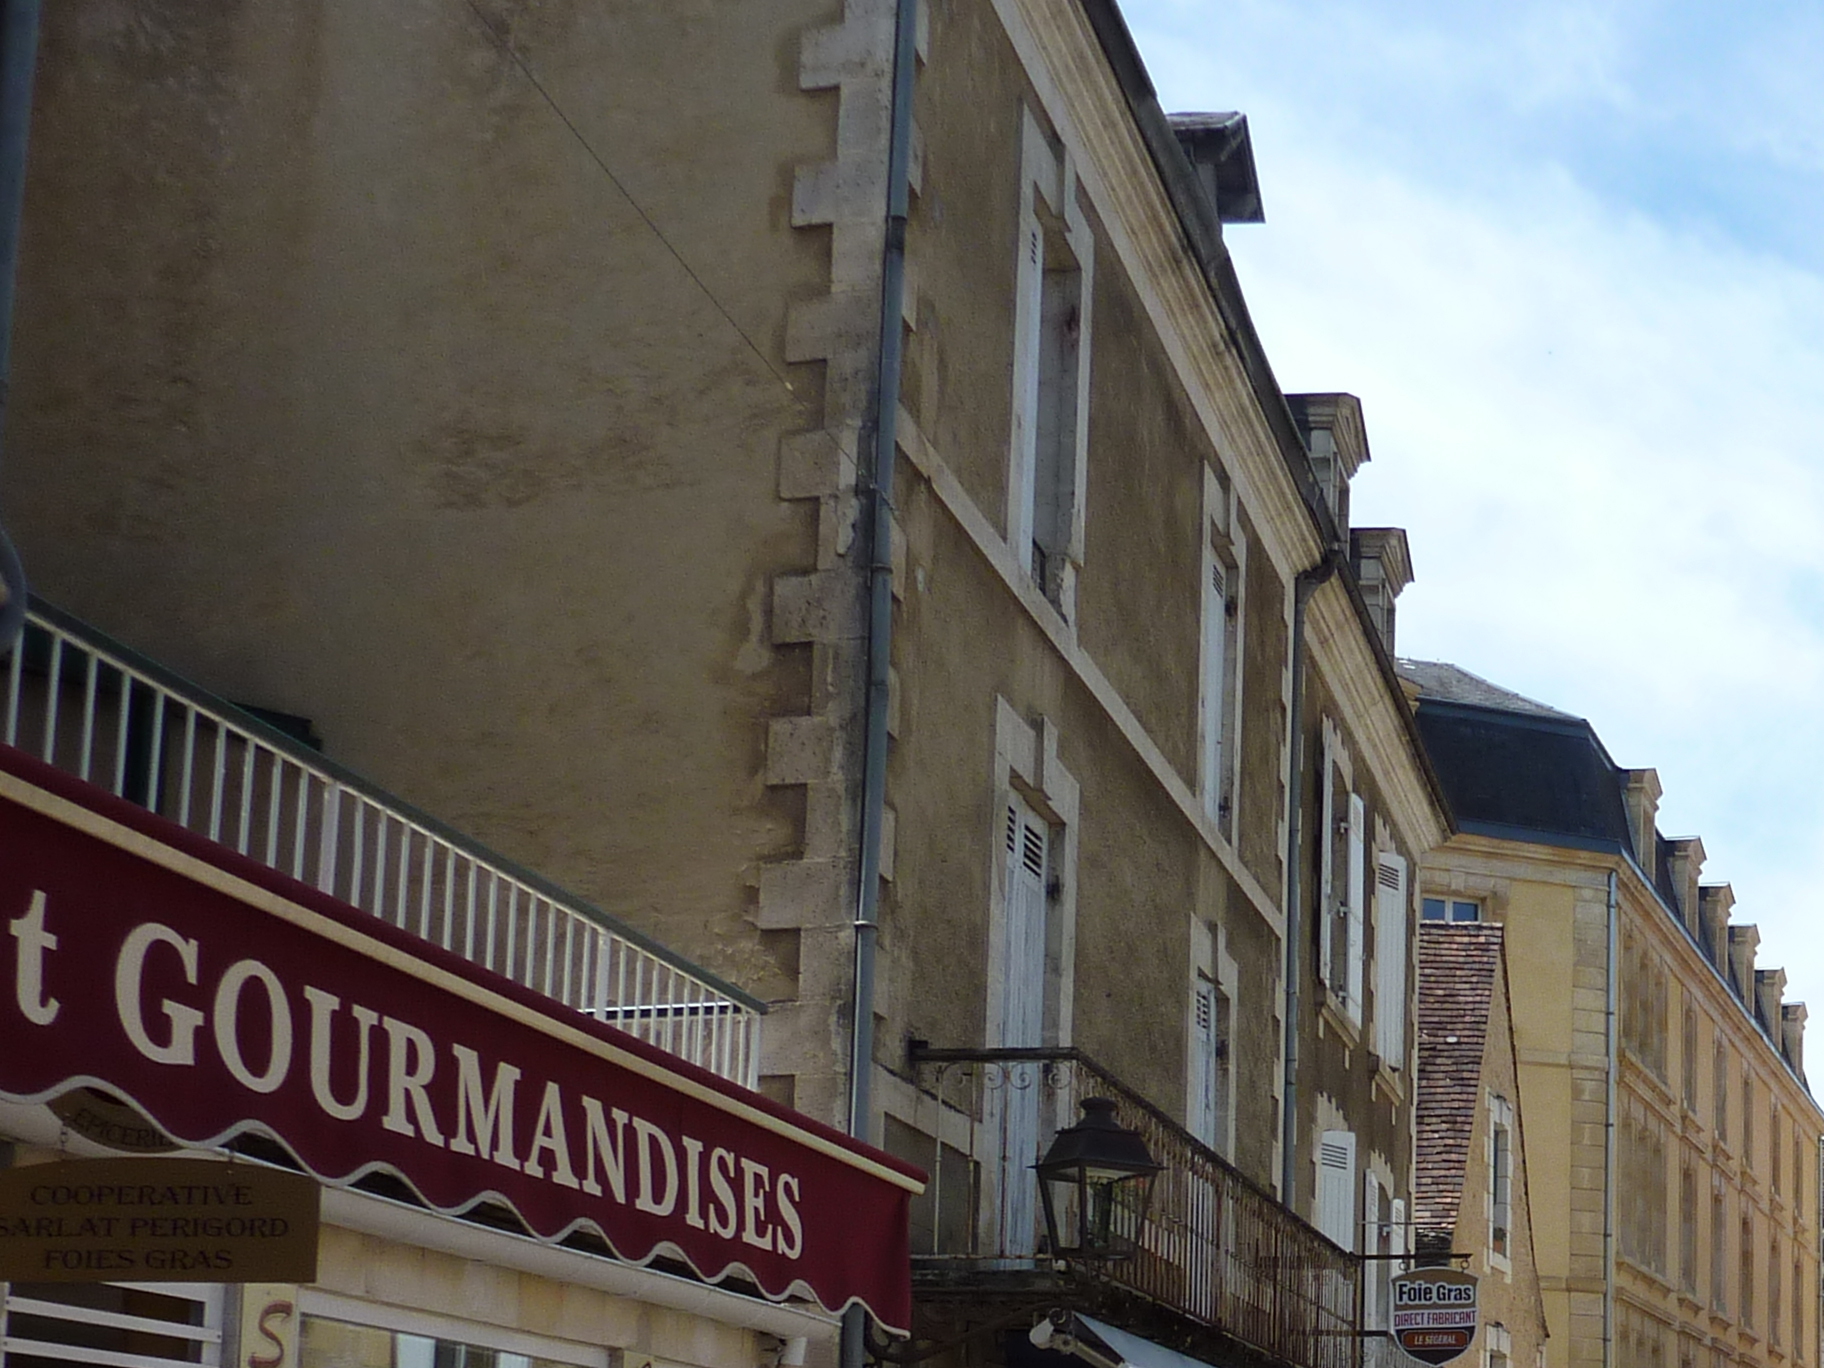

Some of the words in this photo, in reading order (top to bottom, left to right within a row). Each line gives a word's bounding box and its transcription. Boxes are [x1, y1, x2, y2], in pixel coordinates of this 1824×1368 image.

[114, 922, 805, 1261] GOURMANDISES
[30, 1184, 253, 1206] COOPERATIVE
[0, 1216, 120, 1238] SARLAT
[129, 1216, 289, 1238] PERIGORD
[43, 1248, 135, 1271] FOIES
[144, 1248, 234, 1271] GRAS
[1398, 1282, 1433, 1302] Foie
[1436, 1284, 1472, 1302] Gras
[1394, 1312, 1426, 1327] DIRECT
[1427, 1310, 1477, 1326] FABRICANT
